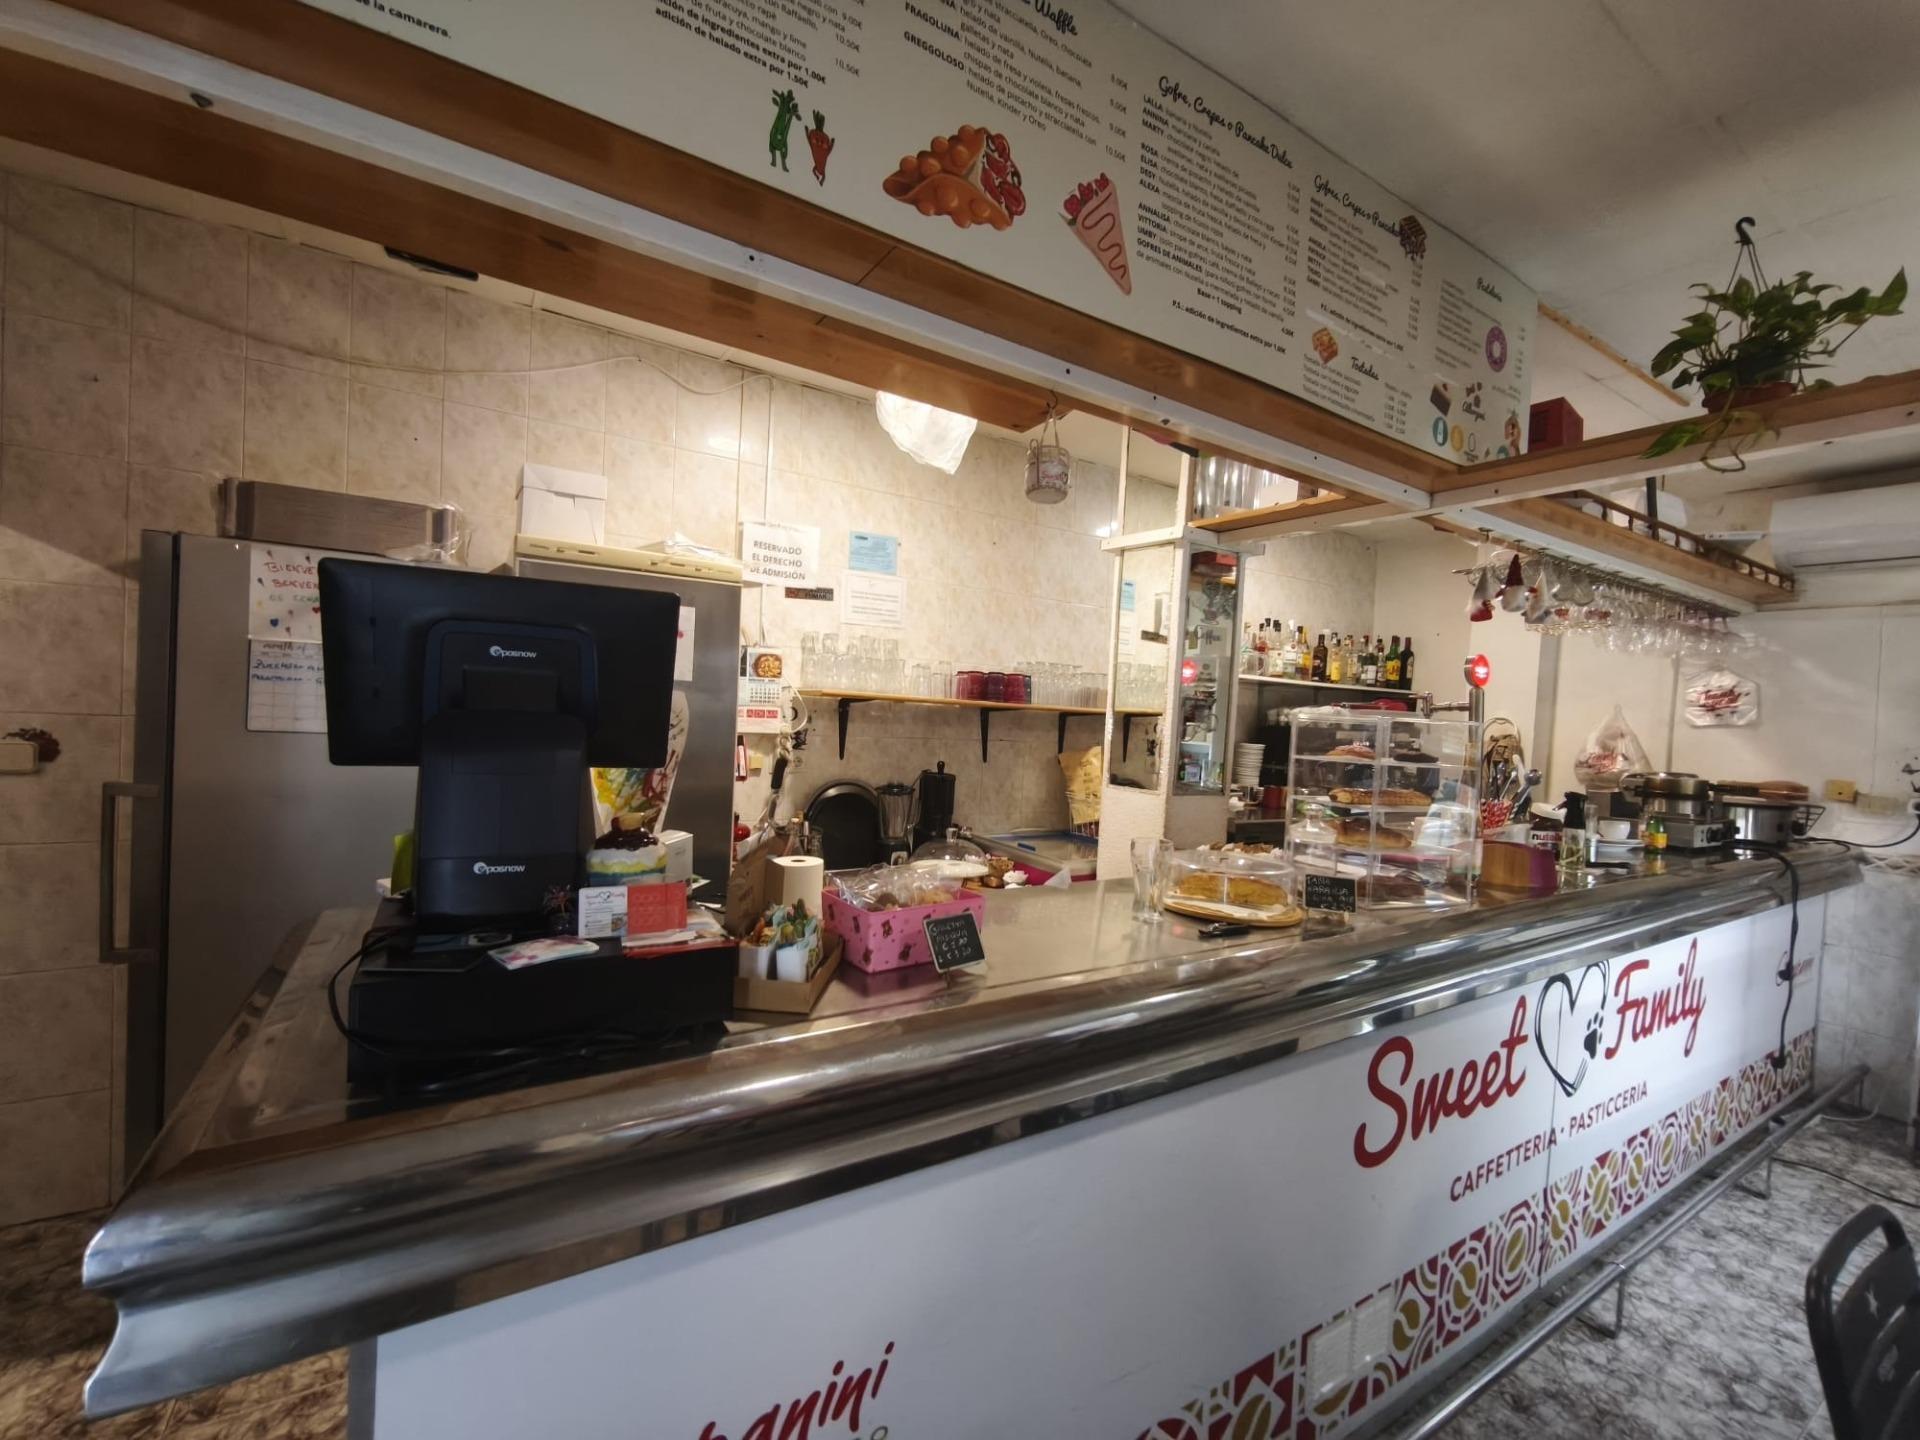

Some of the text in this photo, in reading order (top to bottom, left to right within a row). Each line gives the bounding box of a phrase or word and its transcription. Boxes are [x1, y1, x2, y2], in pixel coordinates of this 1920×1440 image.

[389, 8, 452, 39] camarera.
[655, 7, 692, 31] adición
[694, 26, 706, 37] de
[709, 31, 742, 54] helado
[743, 50, 767, 68] extra
[769, 63, 785, 78] por
[687, 8, 700, 21] de
[702, 14, 761, 51] ingredientes
[762, 46, 786, 64] extra
[787, 59, 803, 73] por
[750, 566, 761, 574] DE
[752, 553, 802, 568] EL DERECHO
[753, 540, 802, 555] RESERVADO
[1353, 937, 1707, 1169] Sweet Family
[1449, 1081, 1648, 1203] CAFFETTERIA PASTICCERIA
